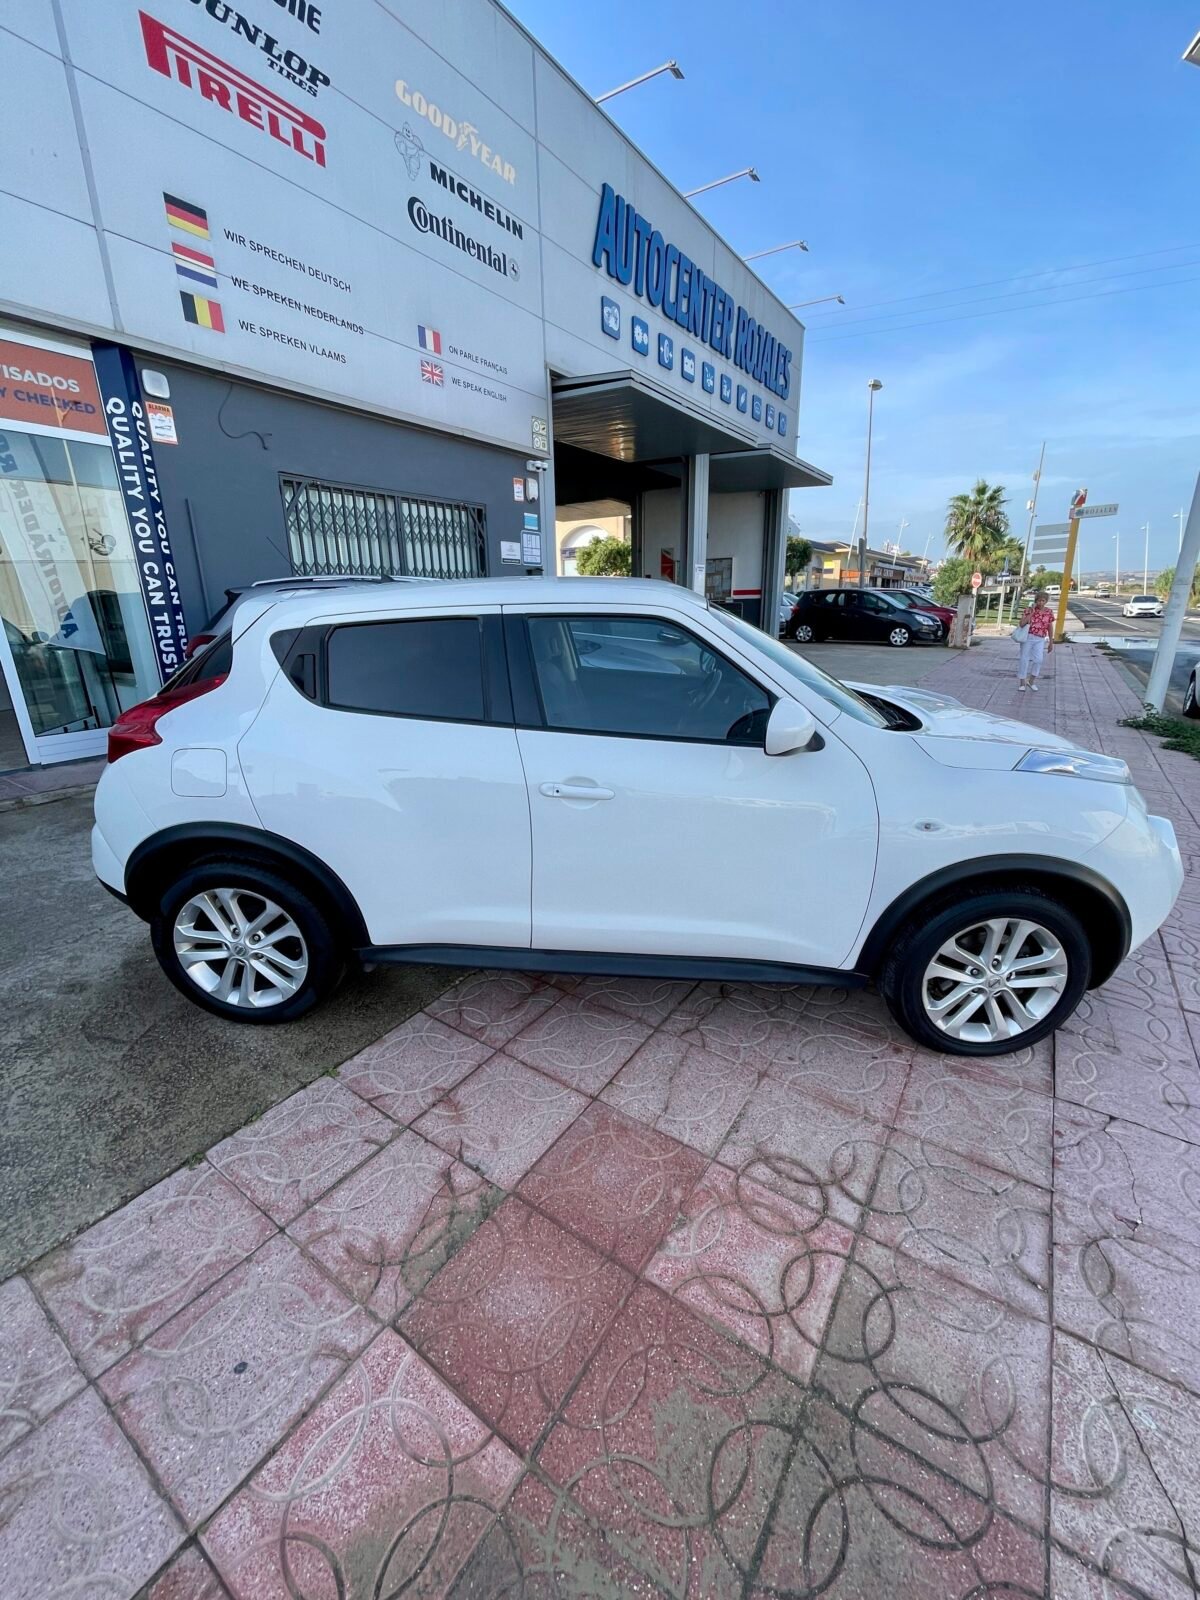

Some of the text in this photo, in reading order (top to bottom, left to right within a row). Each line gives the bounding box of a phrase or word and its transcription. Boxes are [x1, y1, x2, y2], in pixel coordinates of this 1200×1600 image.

[190, 0, 331, 87] UNLOP
[138, 9, 326, 168] PIRELLI
[267, 57, 318, 98] TIRES
[429, 161, 523, 241] MICHELIN
[224, 228, 351, 293] WIR SPRECHEN DEUTSCH
[407, 196, 508, 277] Continental
[231, 276, 364, 335] WE SPREKEN NEDERLANDS
[592, 182, 792, 401] AUTOCENTER ROJALES
[238, 319, 347, 364] WE SPREKEN VLAAMS
[448, 345, 508, 375] ON PARLE FRANÇAIS
[0, 363, 80, 393] ISADOS
[13, 389, 96, 414] CHECKED
[451, 377, 507, 403] WE SPEAK ENGLISH
[106, 397, 145, 501] QUALITY
[131, 507, 156, 553] YOU
[132, 401, 160, 503] QUALITY
[154, 510, 170, 554] YOU
[165, 562, 181, 605] CAN
[143, 561, 166, 605] CAN
